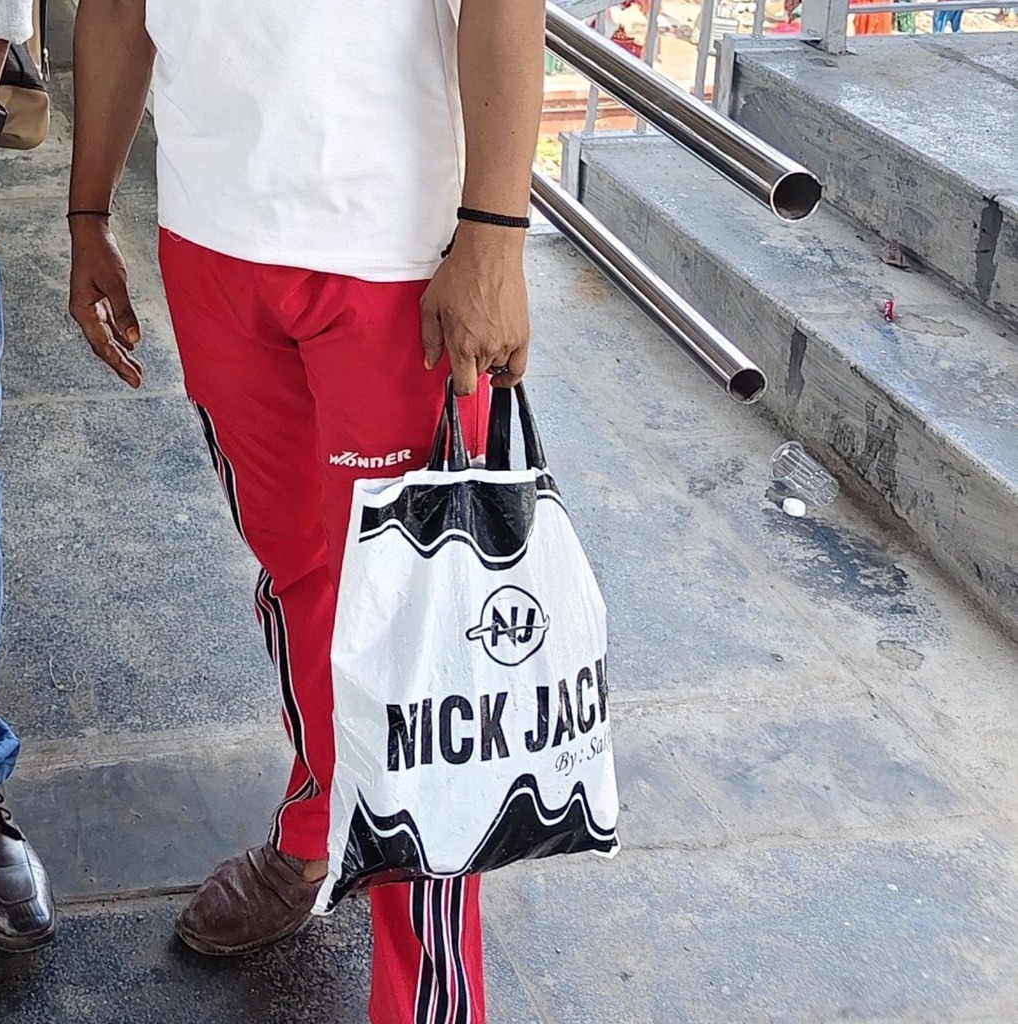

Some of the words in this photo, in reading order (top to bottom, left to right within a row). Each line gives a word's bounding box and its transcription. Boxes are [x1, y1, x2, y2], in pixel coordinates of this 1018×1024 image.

[329, 449, 412, 468] WONDER
[491, 605, 536, 647] NJ
[386, 691, 510, 771] NICK
